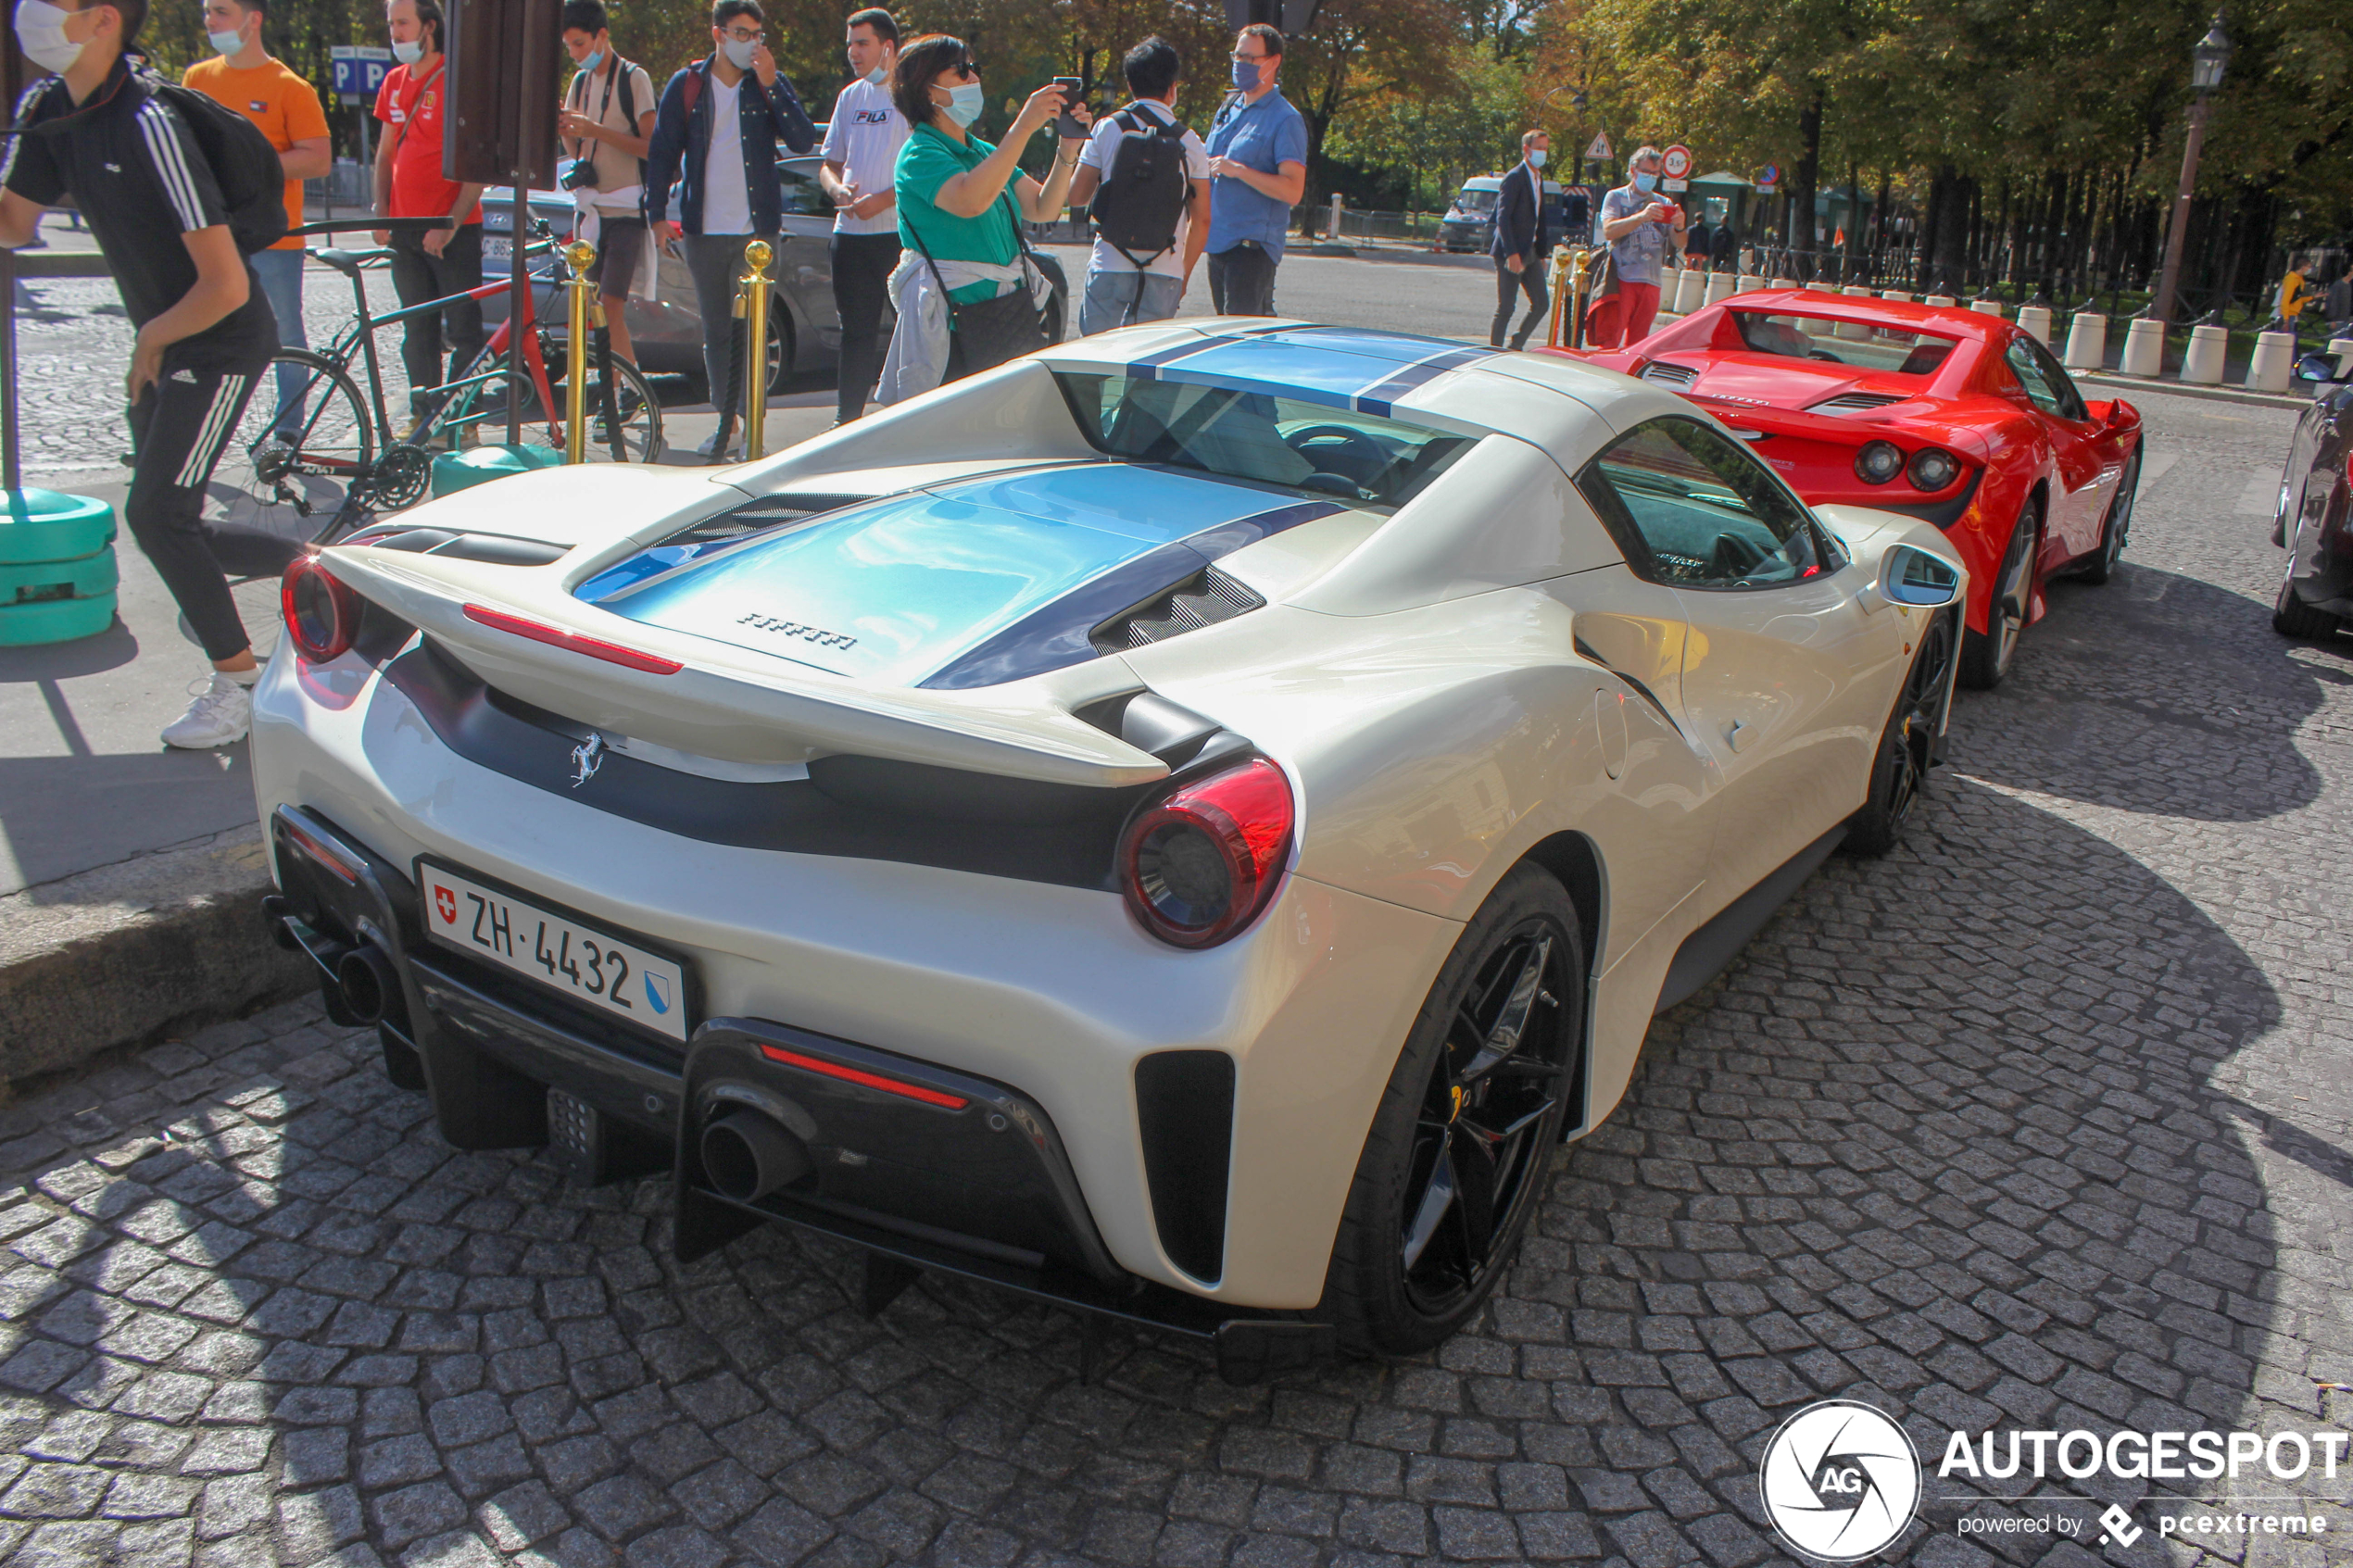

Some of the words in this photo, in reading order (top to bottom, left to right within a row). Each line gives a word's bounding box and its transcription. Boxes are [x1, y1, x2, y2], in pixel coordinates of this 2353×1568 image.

[335, 62, 350, 89] P
[366, 63, 384, 90] P
[856, 111, 887, 123] FILA
